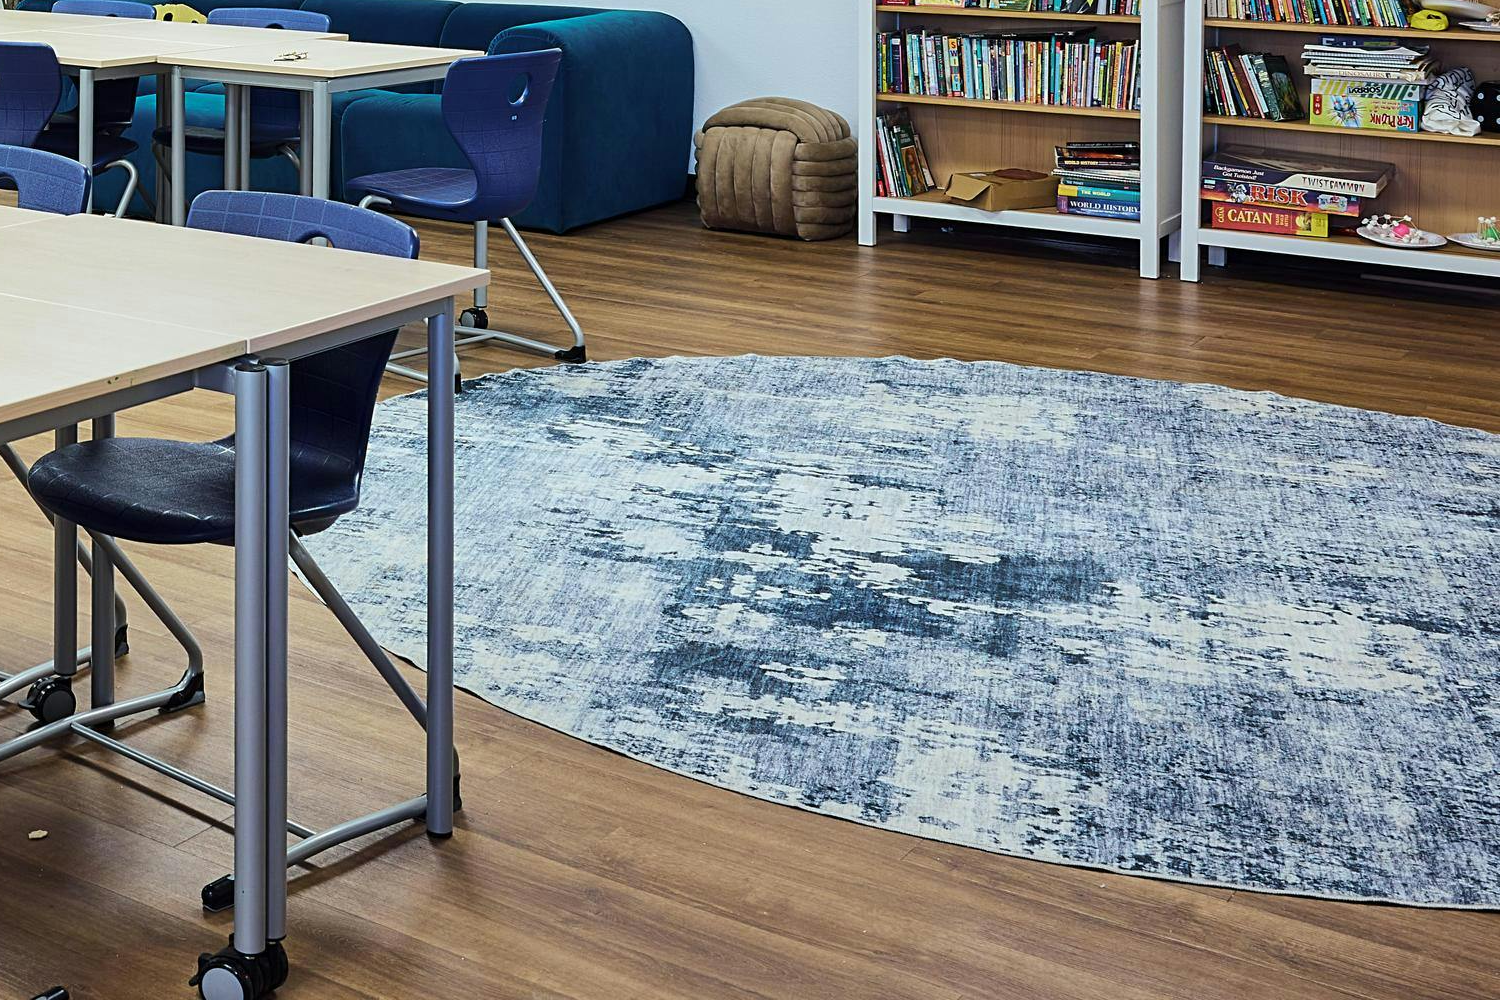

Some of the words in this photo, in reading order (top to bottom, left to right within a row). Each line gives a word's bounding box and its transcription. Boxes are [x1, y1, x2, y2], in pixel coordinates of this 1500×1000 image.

[1338, 70, 1385, 78] DINOSAURS
[1348, 86, 1381, 94] SORRY!
[1213, 164, 1252, 175] Backgammon
[1232, 172, 1258, 180] Twisted!
[1301, 176, 1365, 193] TWISTGAMMON
[1250, 184, 1308, 206] RISK
[1070, 200, 1101, 209] WORLD
[1103, 203, 1139, 213] HISTORY
[1227, 208, 1272, 225] CATAN
